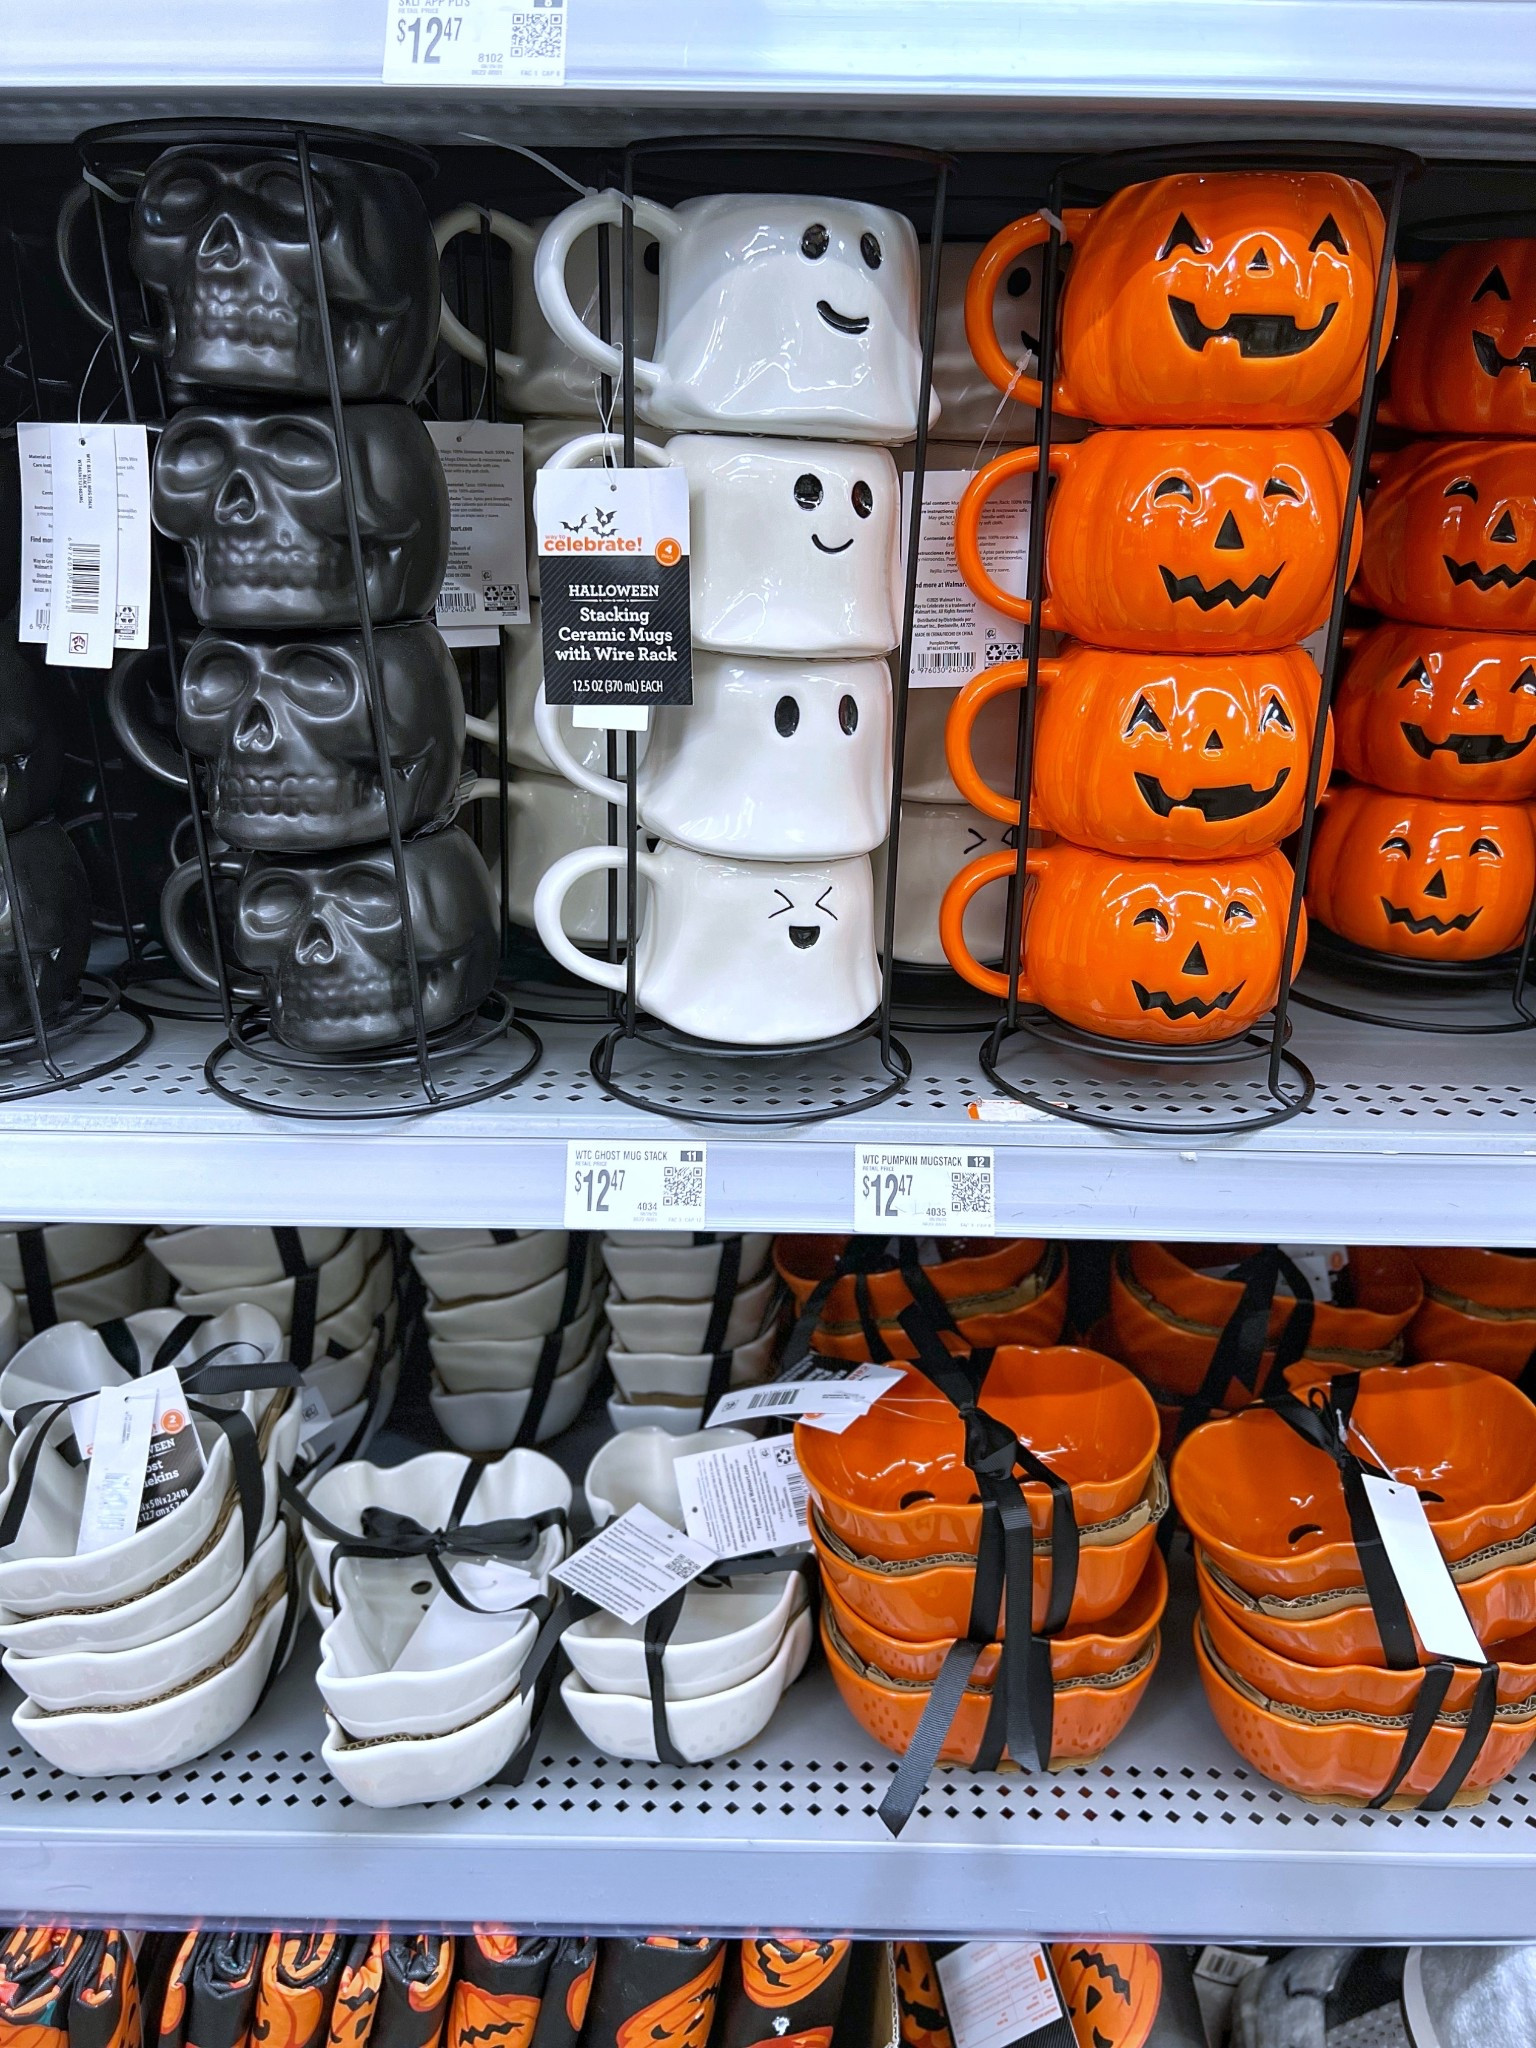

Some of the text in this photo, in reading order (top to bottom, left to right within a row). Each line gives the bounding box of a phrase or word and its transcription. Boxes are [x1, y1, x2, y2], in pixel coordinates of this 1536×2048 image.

[478, 53, 503, 63] 8102
[544, 536, 643, 552] celebrate!
[664, 544, 673, 555] 4
[568, 584, 660, 598] HALLOWEEN
[579, 606, 650, 625] Stacking
[558, 627, 673, 645] Ceramic Mugs
[555, 646, 678, 662] with Wire Rack
[572, 679, 664, 694] 12.5 OZ (370 mL) EACH
[575, 1150, 668, 1161] WTC GHOST MUG STACK
[686, 1151, 697, 1162] 11
[862, 1155, 962, 1167] WTC PUMPKIN MUGSTACK
[973, 1157, 985, 1167] 12
[637, 1202, 657, 1211] 4034
[926, 1208, 947, 1217] 4035
[168, 1415, 177, 1424] 2
